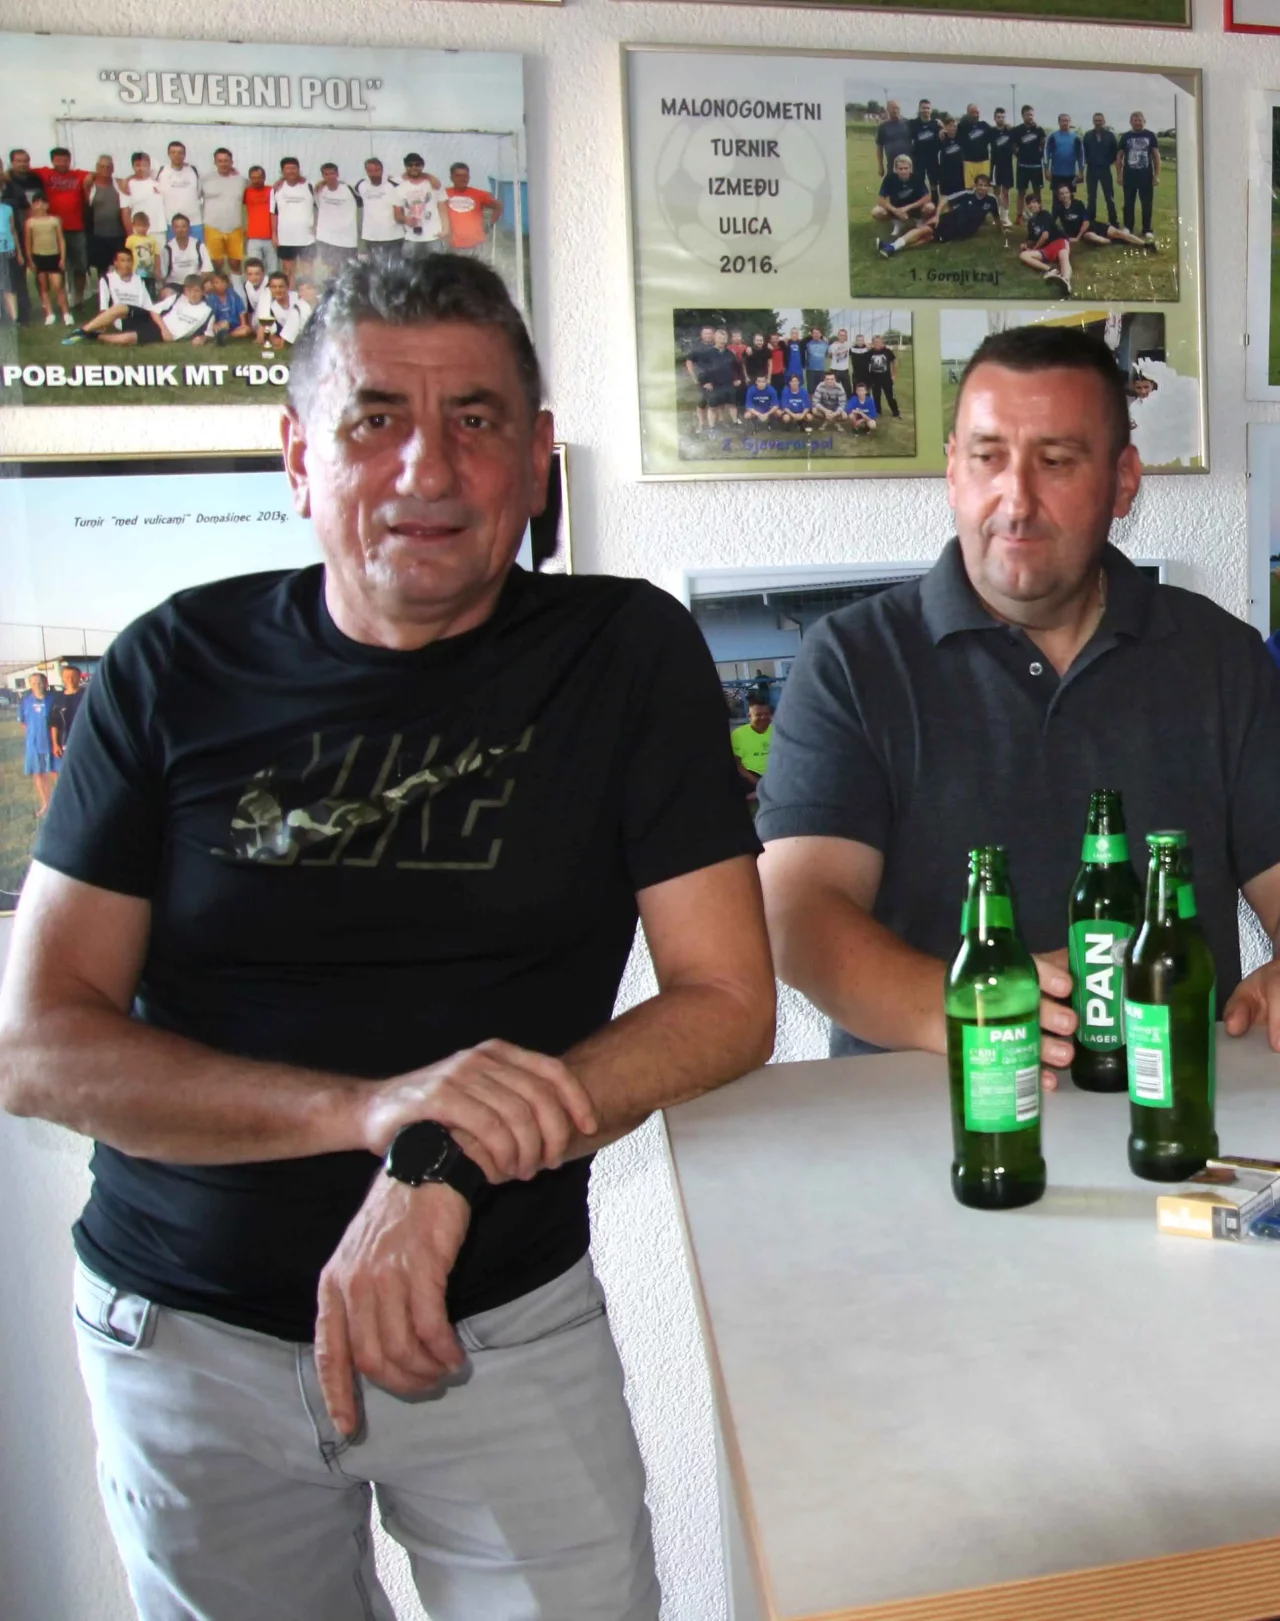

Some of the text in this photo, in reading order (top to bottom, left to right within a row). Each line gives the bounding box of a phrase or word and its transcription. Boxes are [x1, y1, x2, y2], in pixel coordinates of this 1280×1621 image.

[100, 70, 382, 110] “SJEVERNI POL”
[661, 97, 822, 121] MALONOGOMETNI
[710, 138, 780, 158] TURNIR
[709, 177, 779, 197] IZMEĐU
[719, 216, 772, 235] ULICA
[719, 255, 777, 274] 2016.
[2, 364, 179, 387] POBJEDNIK
[185, 365, 228, 387] MT
[74, 516, 104, 529] Turnir
[196, 512, 252, 525] Domašinec
[256, 510, 289, 524] 2013g.
[1085, 933, 1114, 1027] PAN
[990, 1027, 1026, 1044] PAN
[1084, 1033, 1118, 1044] LAGER
